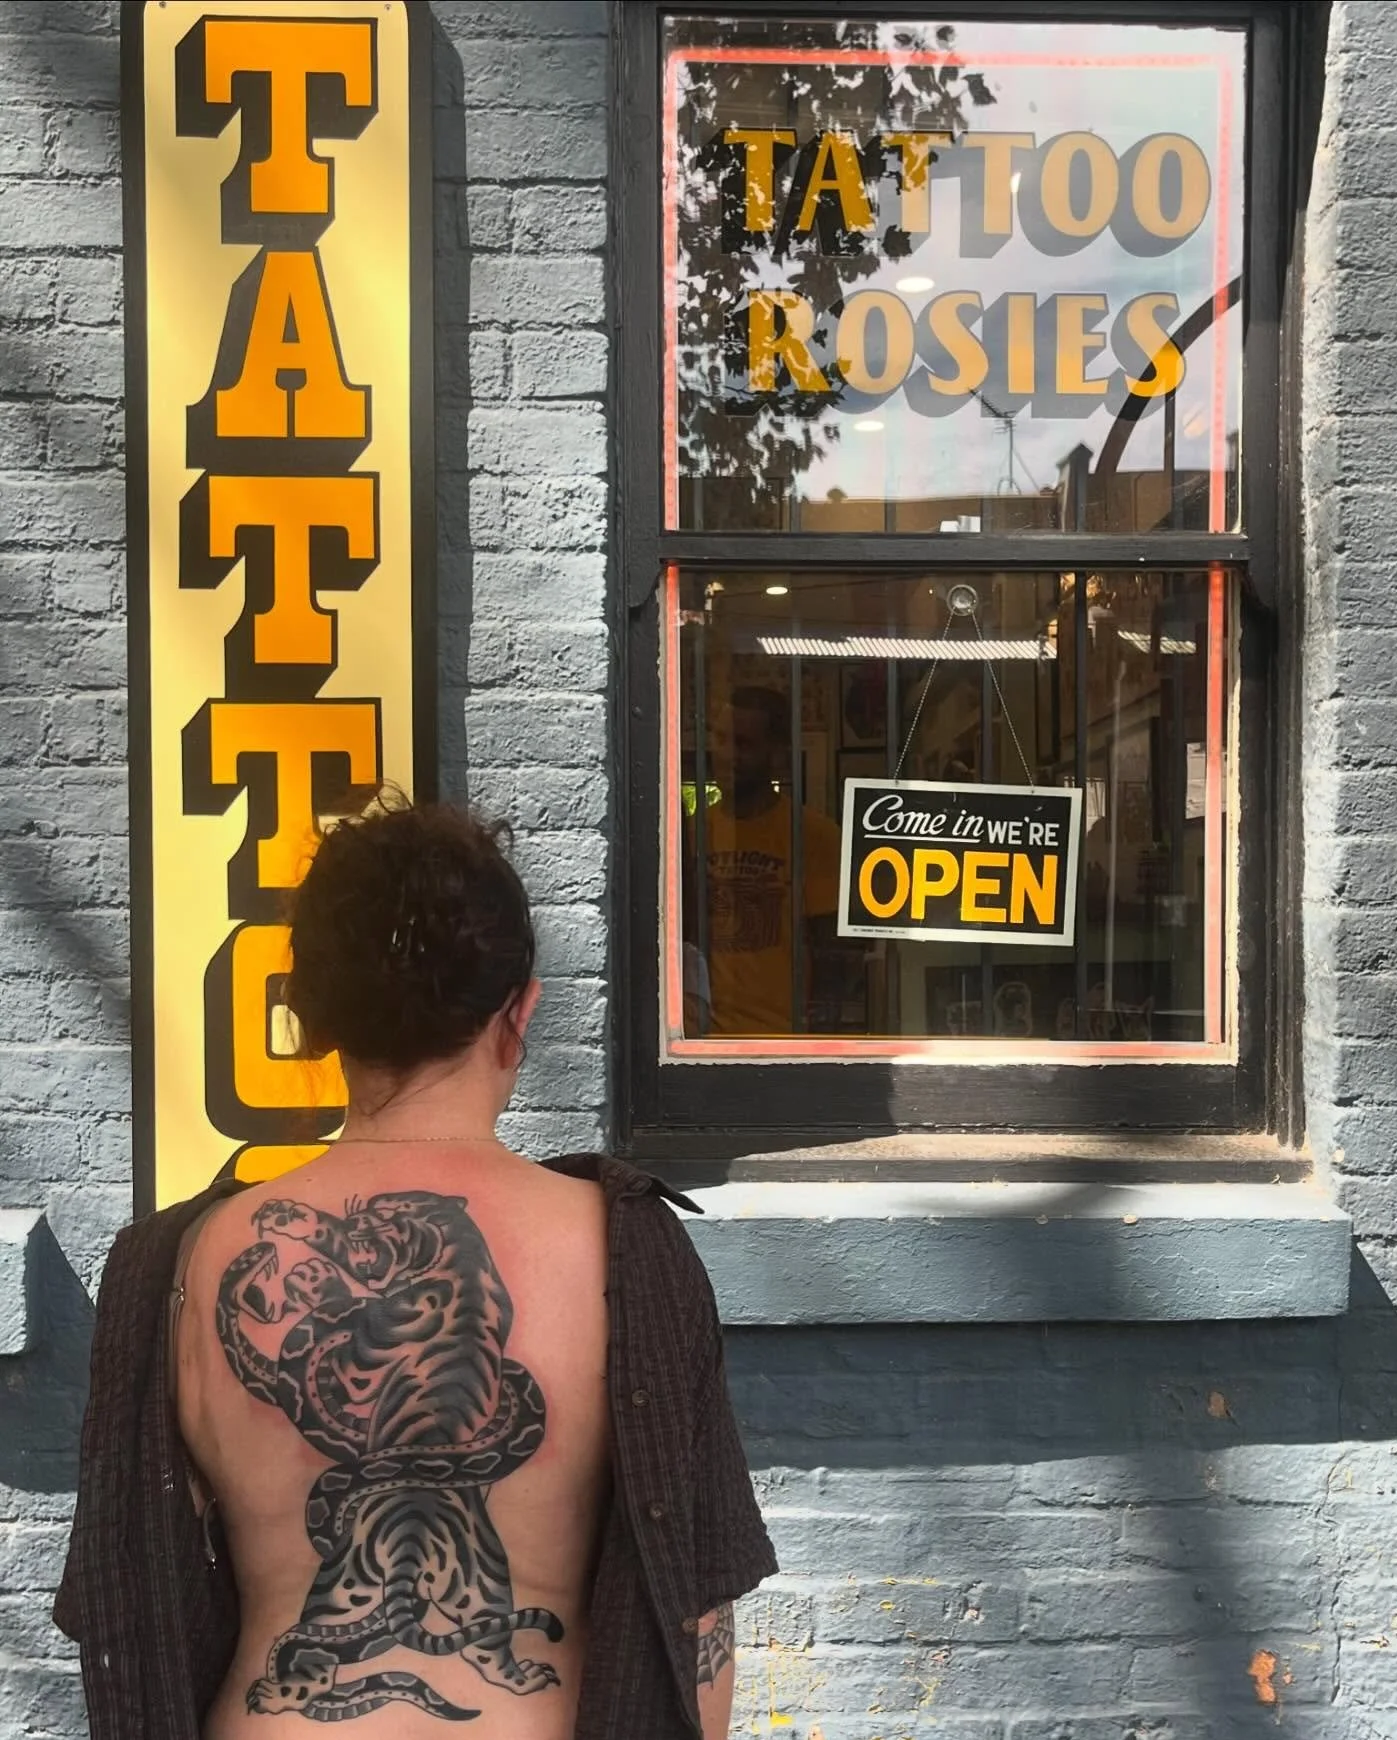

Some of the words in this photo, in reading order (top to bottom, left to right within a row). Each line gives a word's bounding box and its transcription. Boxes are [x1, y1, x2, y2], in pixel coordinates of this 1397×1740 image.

[716, 130, 1211, 248] TATTOO
[738, 290, 1187, 408] ROSIES
[188, 18, 378, 1183] TATTO
[862, 794, 948, 836] Come
[952, 809, 984, 837] in
[987, 816, 1060, 846] WE'RE
[859, 846, 1059, 925] OPEN
